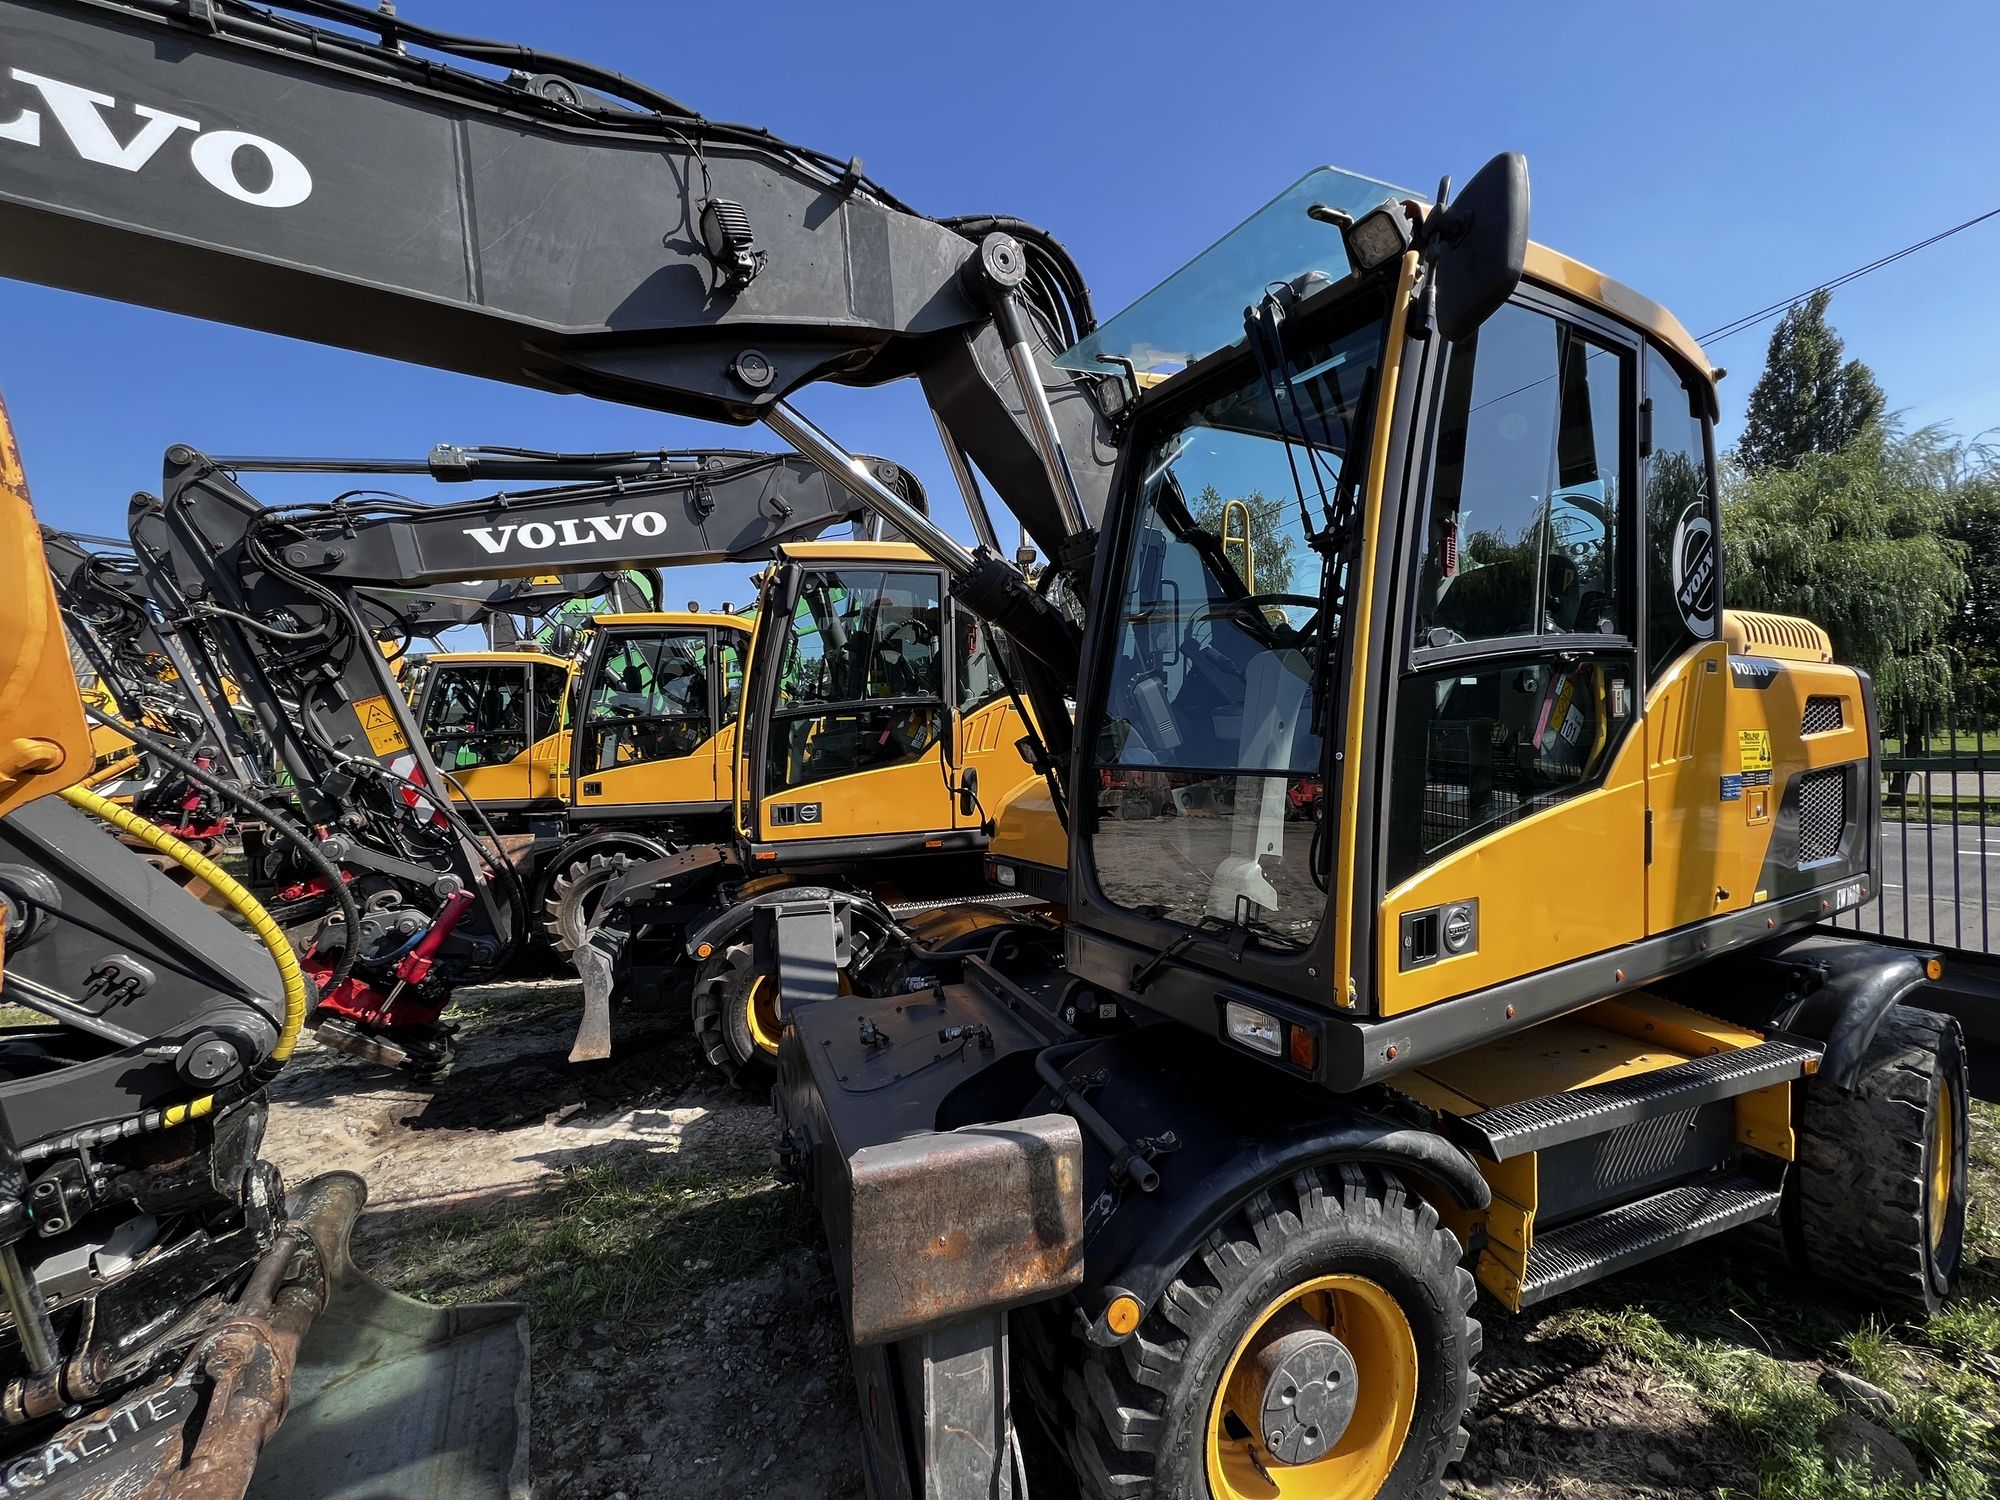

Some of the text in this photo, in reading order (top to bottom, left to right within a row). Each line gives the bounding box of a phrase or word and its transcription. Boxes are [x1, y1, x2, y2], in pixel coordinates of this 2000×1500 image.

[0, 67, 313, 208] VO
[463, 511, 667, 554] VOLVO
[1730, 661, 1769, 677] VOLVO
[0, 1399, 178, 1498] CALITE
